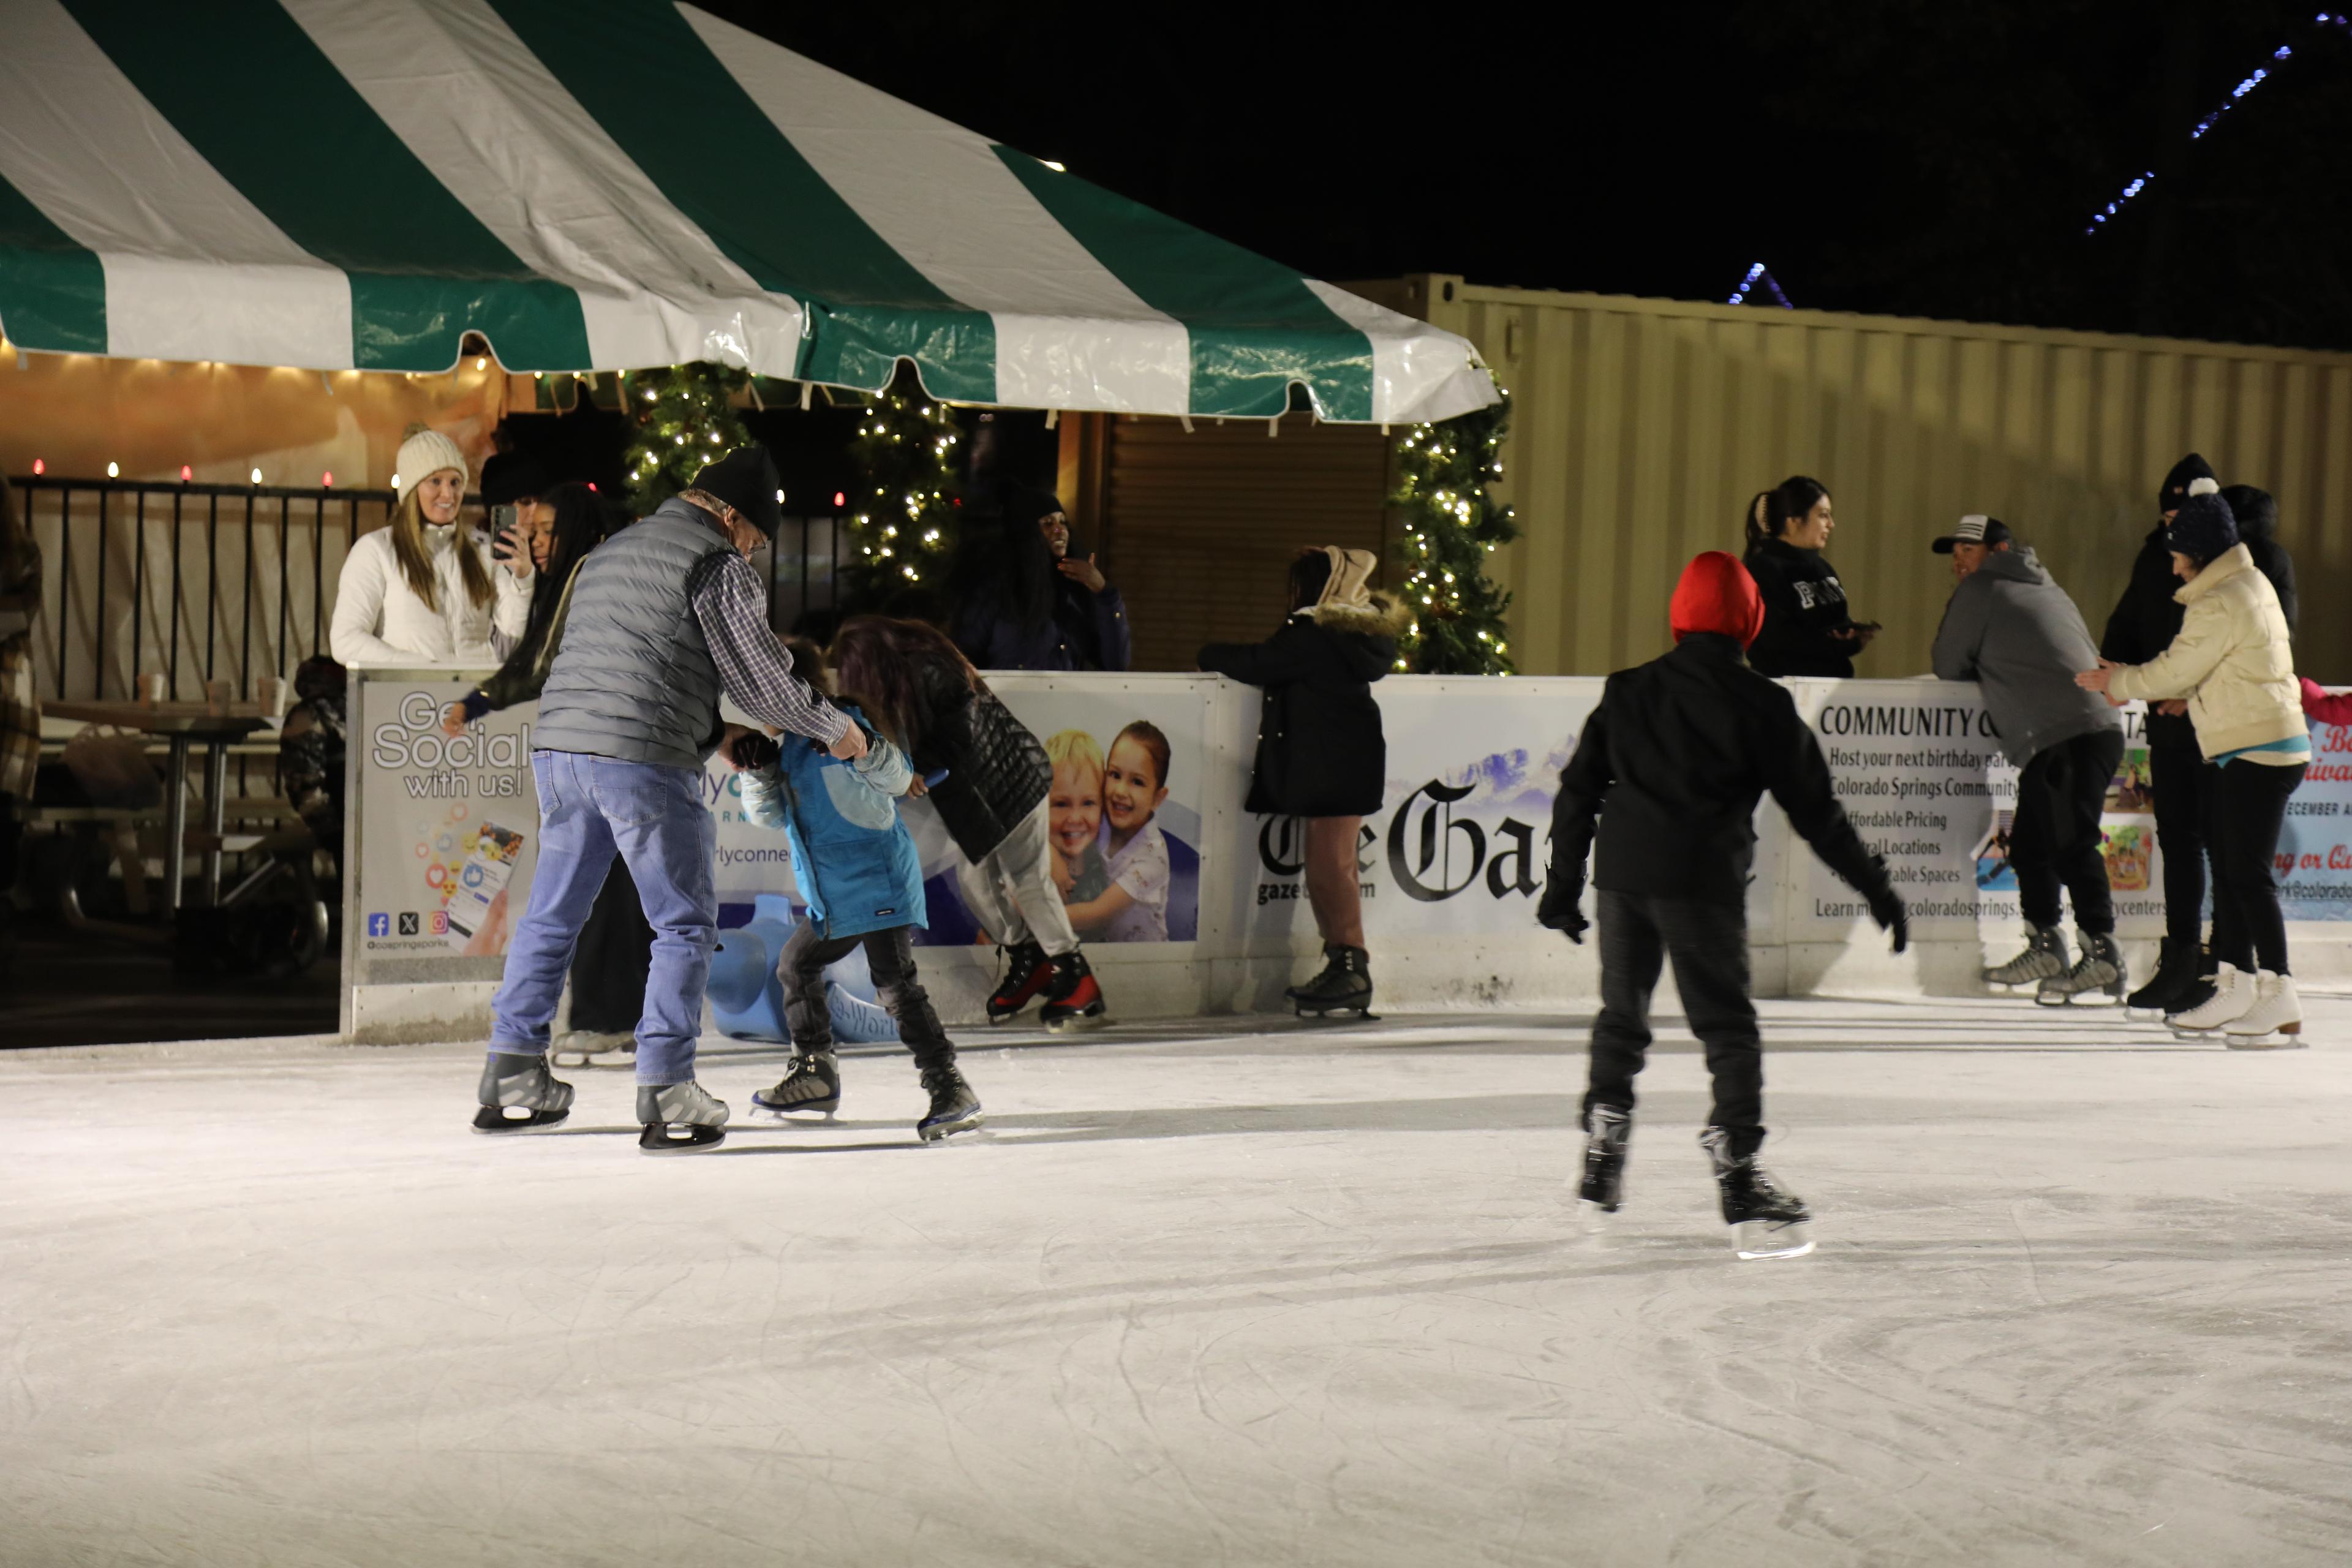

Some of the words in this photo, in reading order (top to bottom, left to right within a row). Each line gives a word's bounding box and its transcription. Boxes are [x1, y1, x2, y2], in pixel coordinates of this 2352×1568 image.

[399, 691, 478, 731] Ge
[1820, 706, 1973, 736] COMMUNITY
[372, 722, 530, 769] Social
[1830, 747, 1861, 766] Host
[1863, 753, 1893, 771] your
[1895, 750, 1925, 766] next
[1928, 748, 1981, 771] birthday
[1985, 753, 2017, 772] par
[403, 767, 469, 799] with
[478, 767, 523, 797] us!
[1892, 777, 1942, 799] Springs
[1945, 777, 2021, 801] Community
[1849, 811, 1903, 827] ffordable
[1905, 811, 1947, 831] Pricing
[2286, 802, 2339, 816] ECEMBER
[1256, 813, 1378, 876] Te
[1884, 839, 1941, 855] Locations
[2300, 853, 2322, 870] or
[1920, 866, 1960, 886] Spaces
[1816, 898, 1854, 917] Learn
